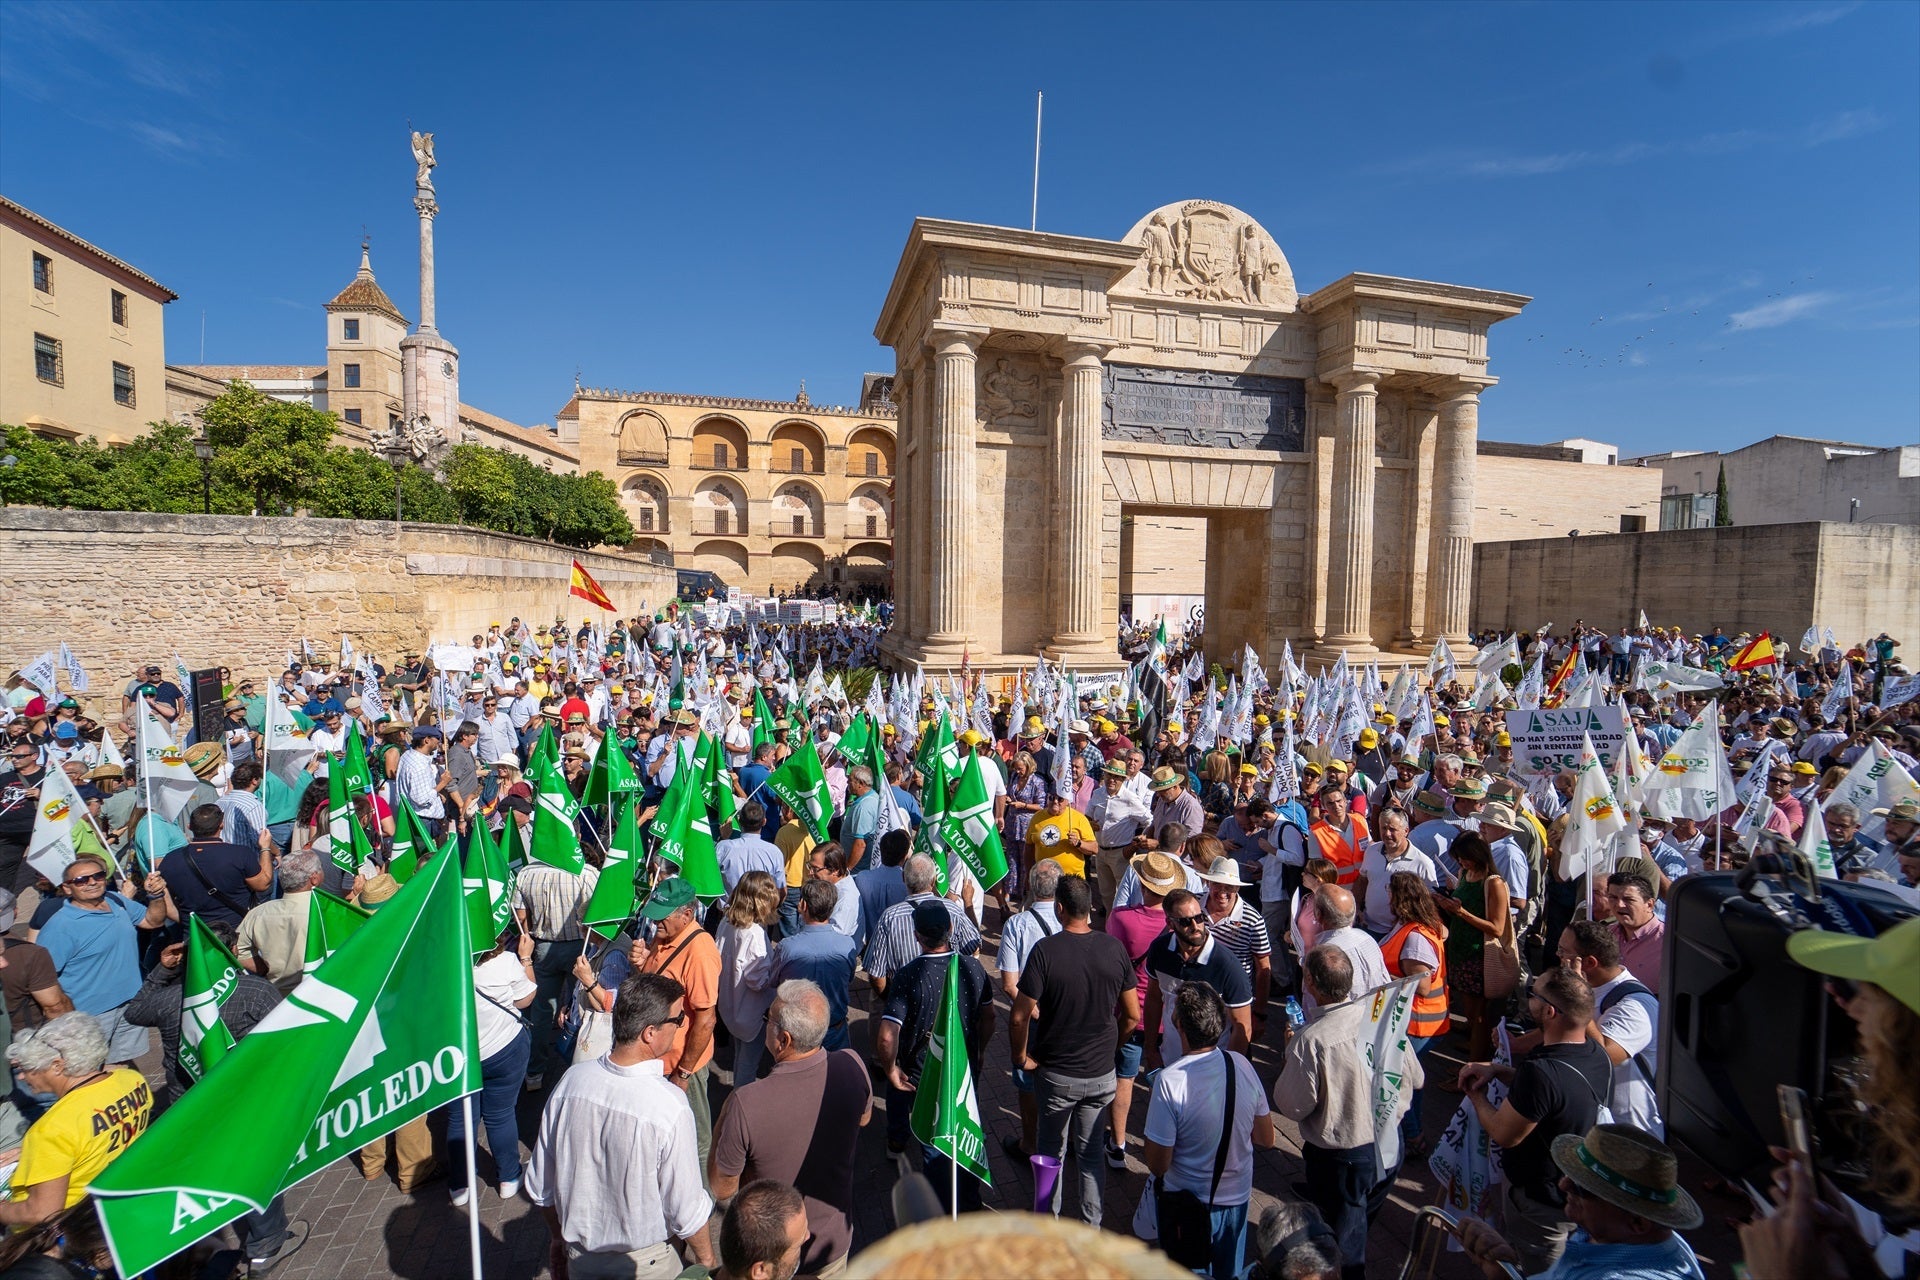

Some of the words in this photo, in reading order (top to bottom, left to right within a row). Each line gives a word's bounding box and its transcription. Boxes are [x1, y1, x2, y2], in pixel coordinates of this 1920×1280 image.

[368, 691, 384, 713] CAMPO
[1526, 708, 1604, 734] ASAJA
[1547, 726, 1581, 734] SEVILLA
[1527, 742, 1543, 750] SIN
[1528, 735, 1546, 743] HAY
[1548, 733, 1623, 743] SOSTENILIDAD
[841, 745, 862, 763] ASAJA
[1275, 765, 1288, 793] CAMPO
[774, 782, 800, 808] ASAJA
[798, 805, 825, 845] TOLEDO
[950, 829, 988, 879] TOLEDO
[314, 1045, 468, 1153] TOLEDO
